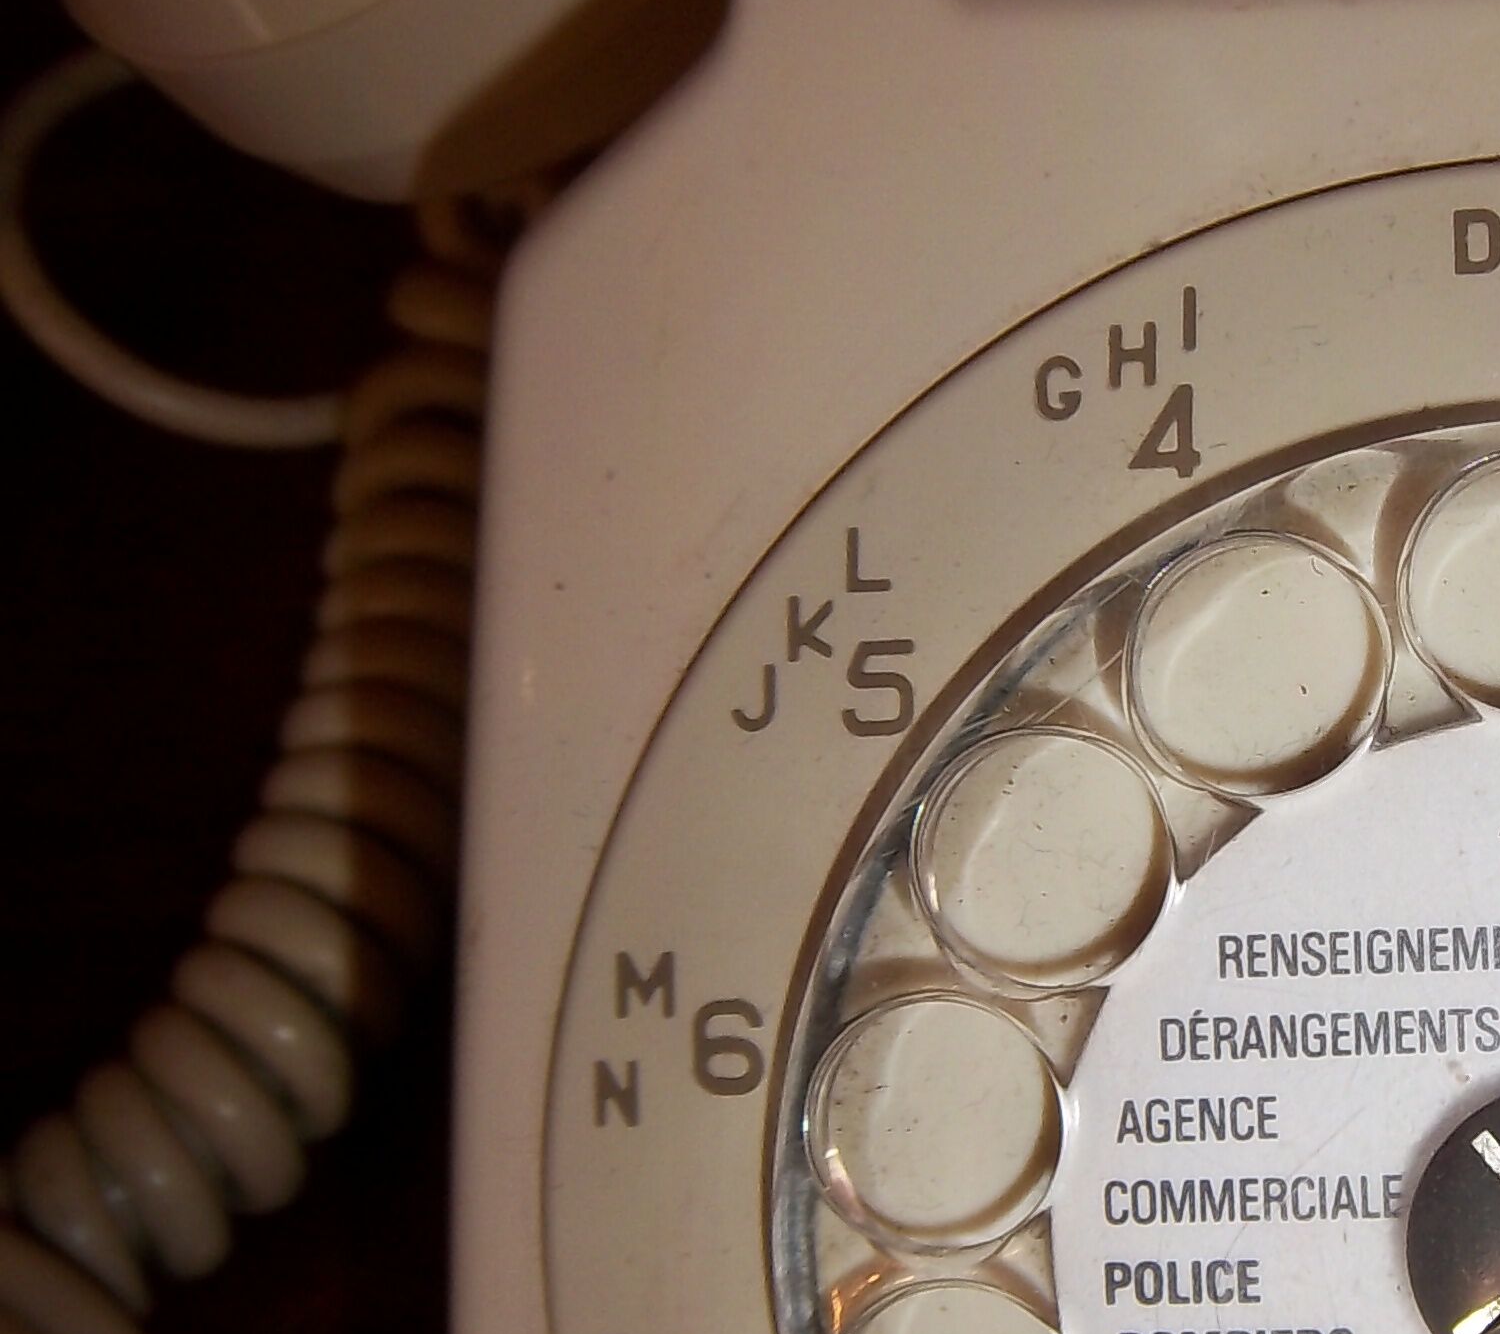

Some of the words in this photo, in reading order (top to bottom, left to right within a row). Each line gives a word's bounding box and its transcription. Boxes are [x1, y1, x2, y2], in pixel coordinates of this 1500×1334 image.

[1127, 383, 1201, 478] 4
[841, 638, 915, 738] 5
[691, 998, 765, 1097] 6
[1115, 1094, 1280, 1145] AGENCE
[1103, 1173, 1402, 1225] COMMERCIALE
[1104, 1258, 1263, 1307] POLICE
